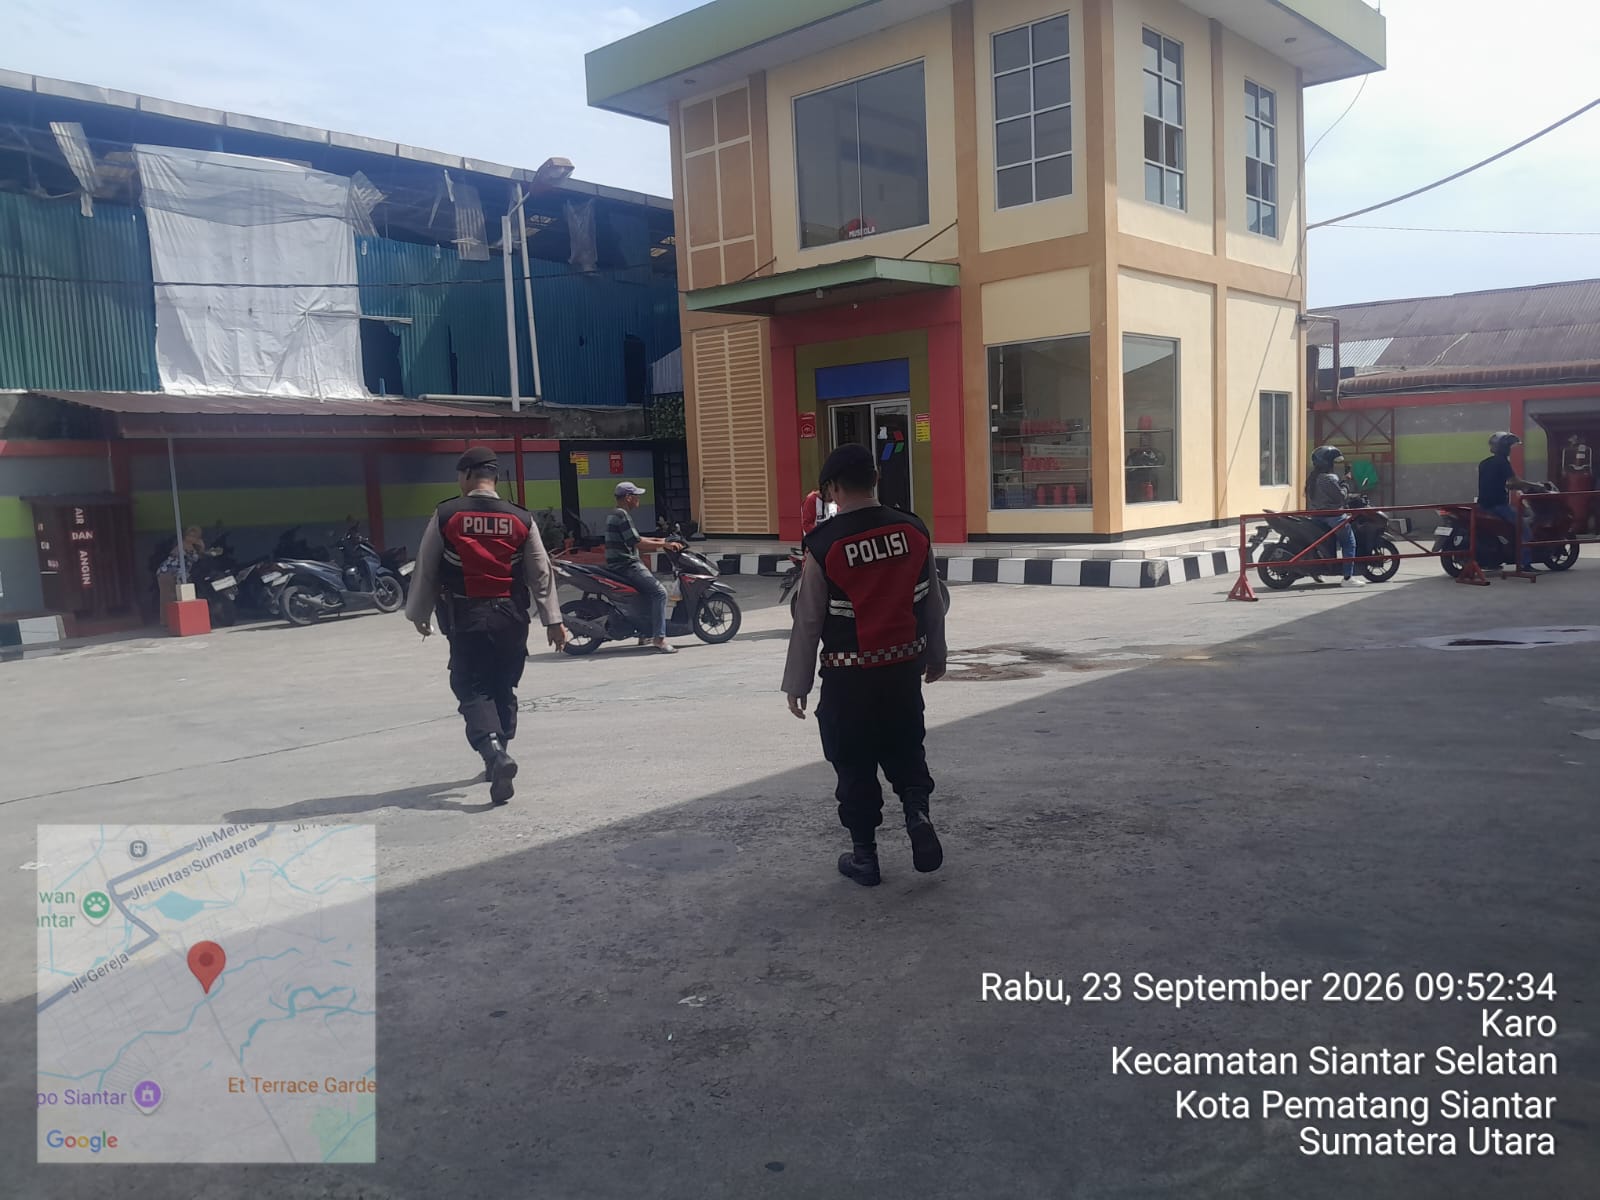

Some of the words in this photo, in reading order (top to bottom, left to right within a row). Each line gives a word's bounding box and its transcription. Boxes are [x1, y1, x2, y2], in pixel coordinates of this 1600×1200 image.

[75, 508, 85, 525] AIR
[462, 516, 513, 535] POLISI
[71, 531, 94, 541] DAN
[844, 531, 909, 568] POLISI
